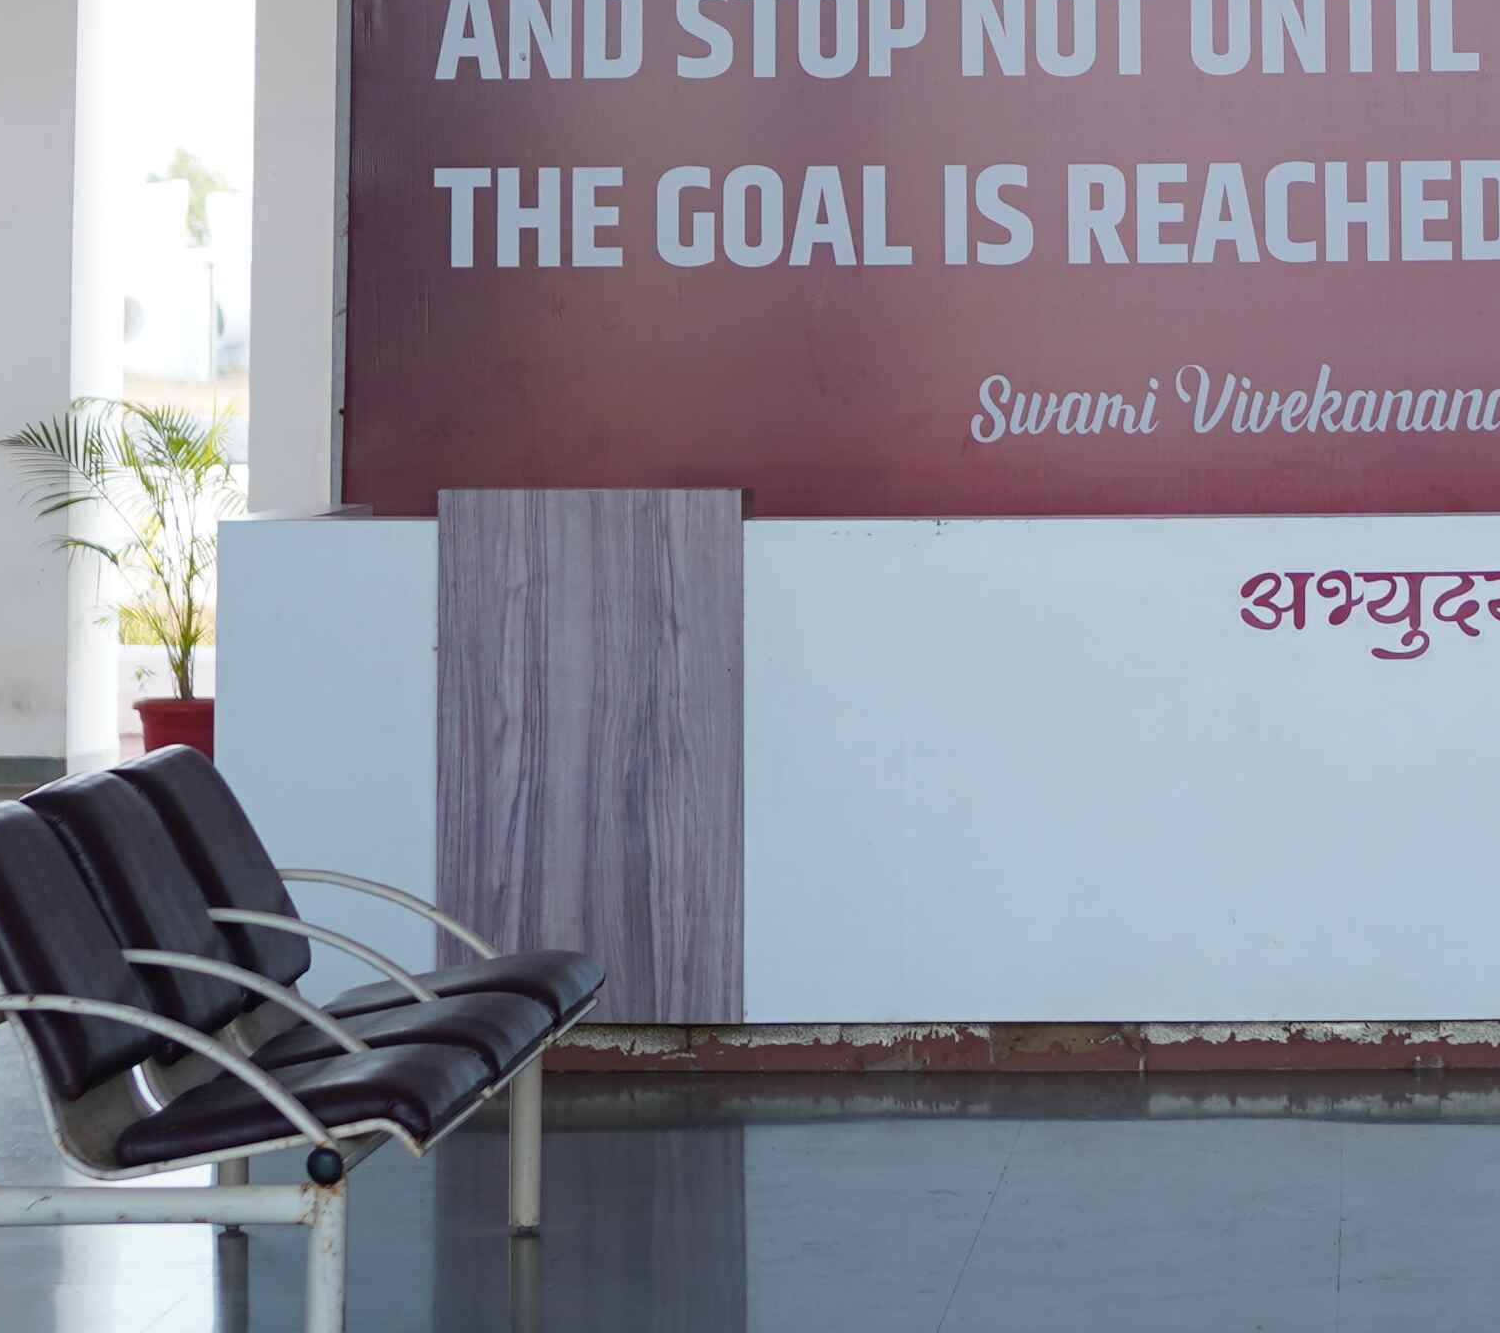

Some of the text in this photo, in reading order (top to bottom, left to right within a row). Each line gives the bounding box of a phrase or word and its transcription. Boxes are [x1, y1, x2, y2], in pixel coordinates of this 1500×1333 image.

[434, 166, 624, 268] THE
[656, 164, 913, 268] GOAL
[943, 163, 1034, 266] IS
[970, 374, 1160, 443] Swami
